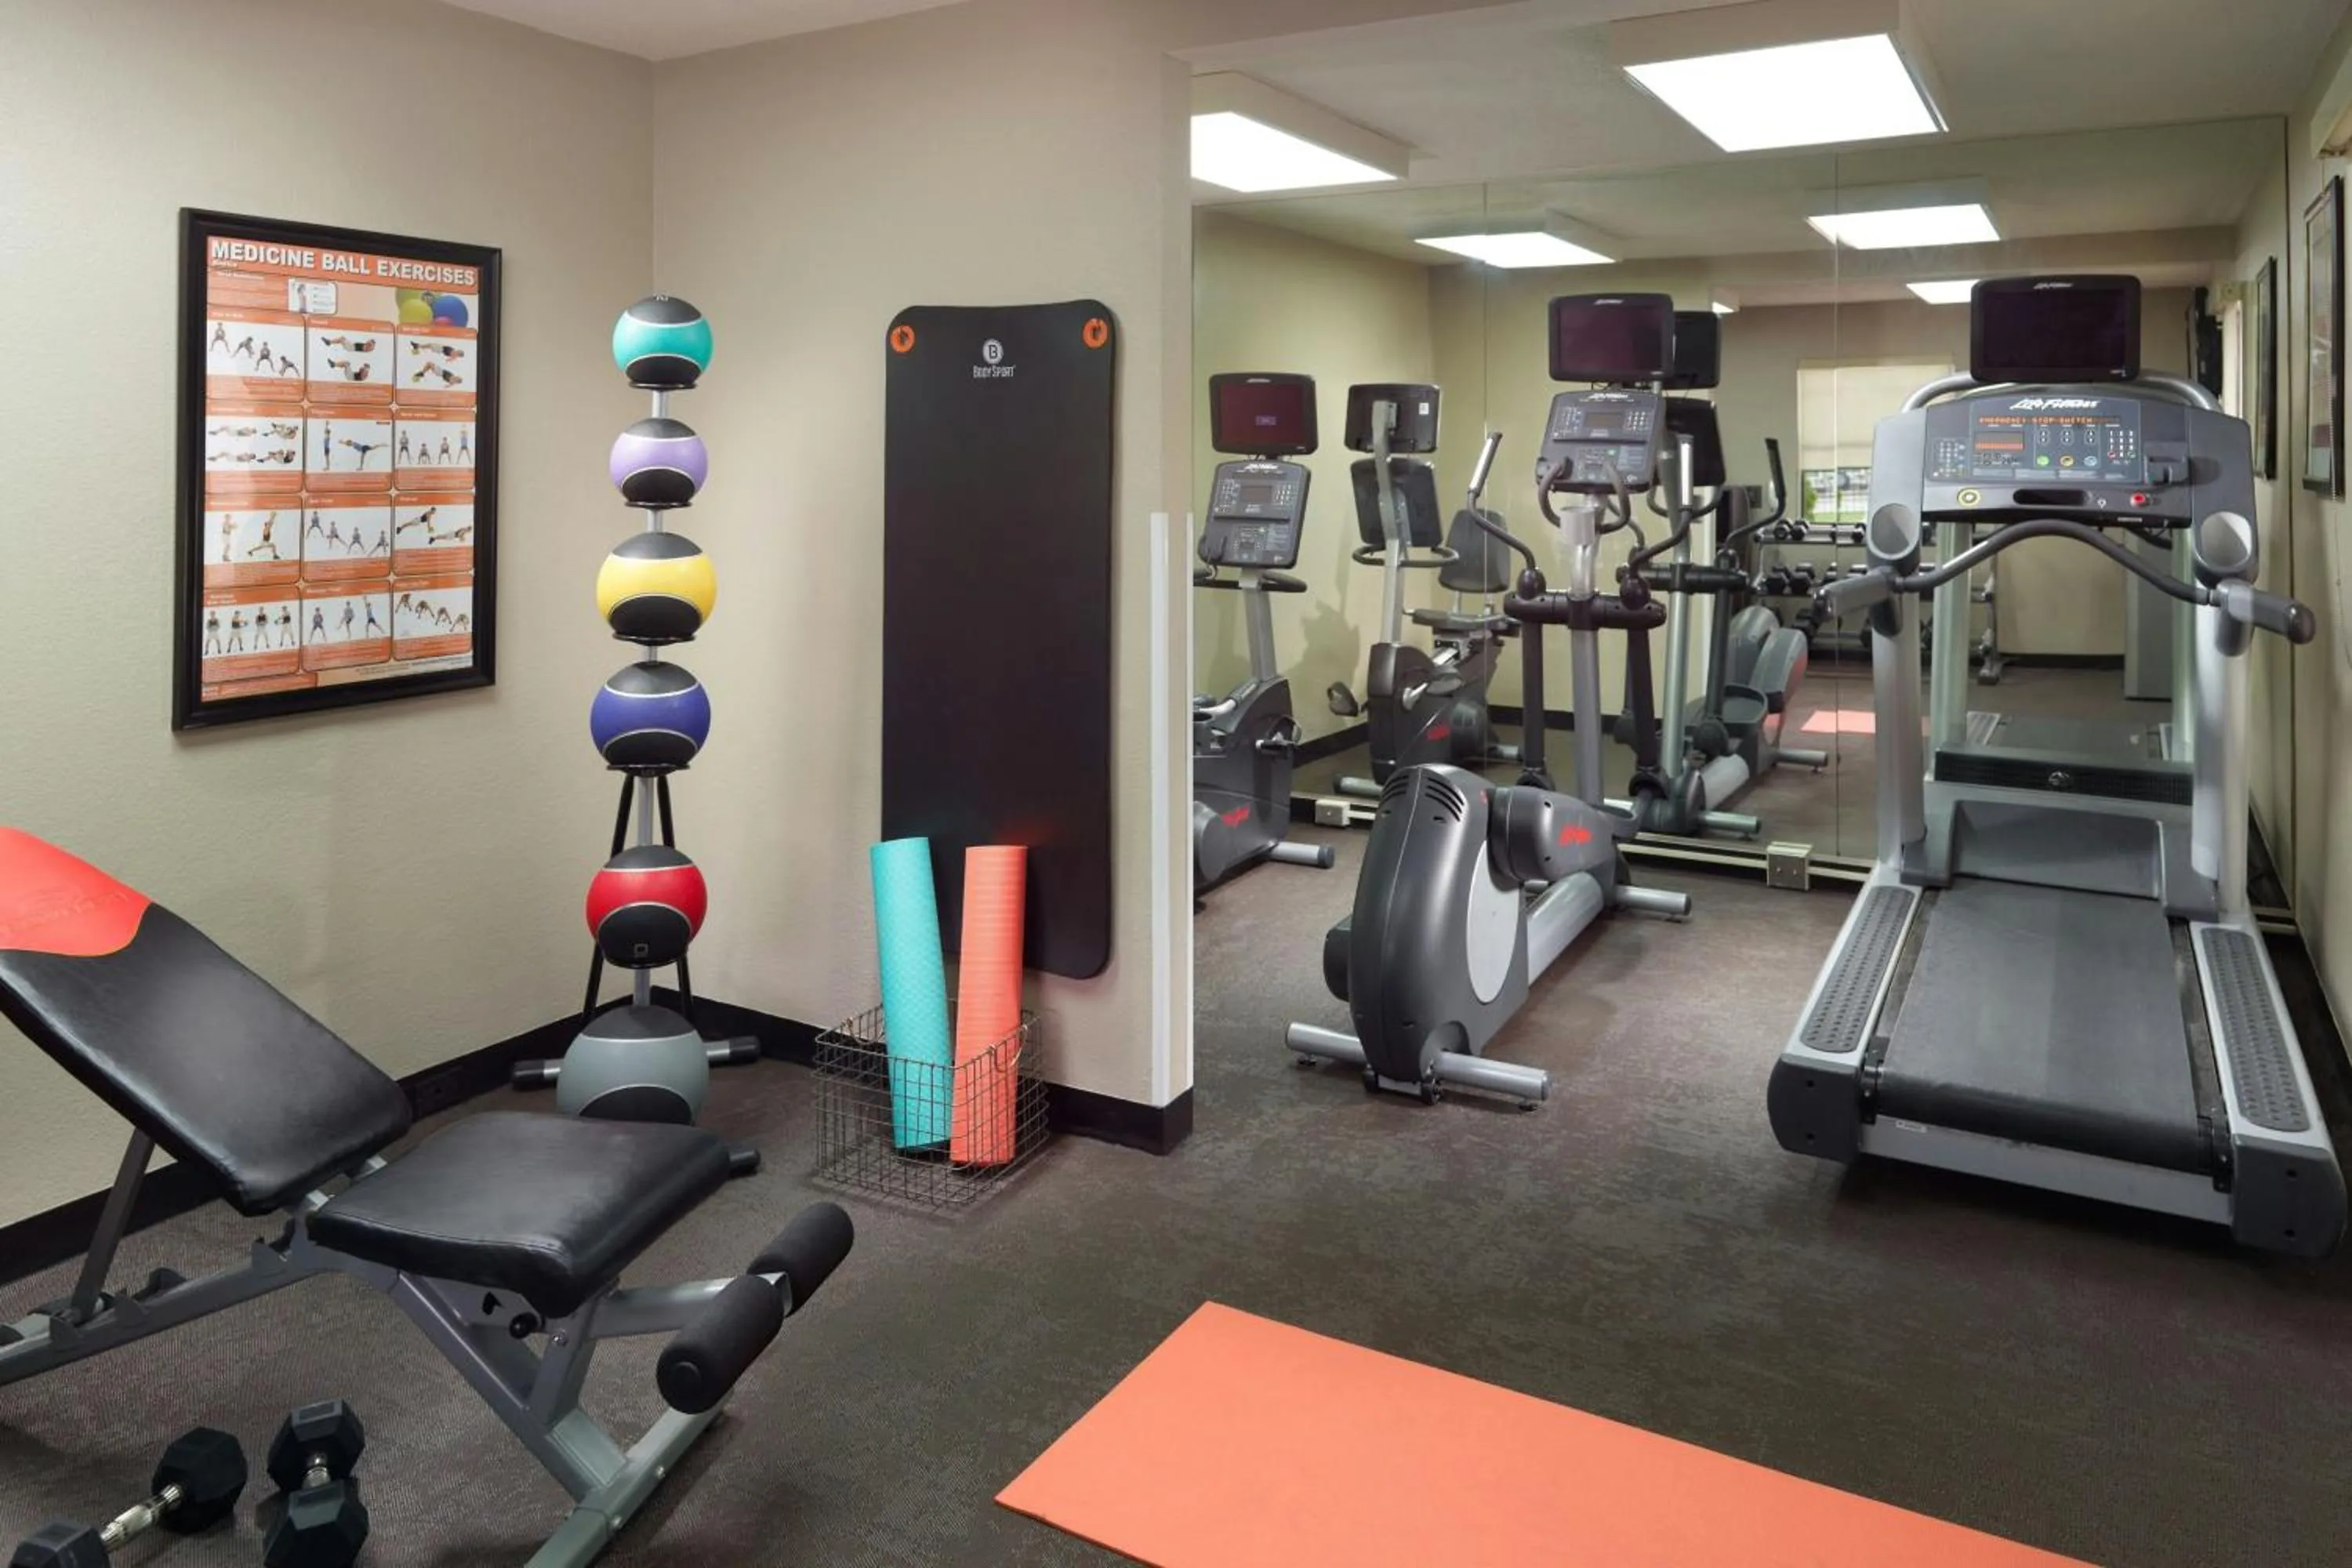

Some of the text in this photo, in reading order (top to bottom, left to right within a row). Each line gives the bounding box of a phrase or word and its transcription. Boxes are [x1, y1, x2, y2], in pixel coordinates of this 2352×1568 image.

[212, 239, 475, 286] MEDICINE BALL EXERCISES
